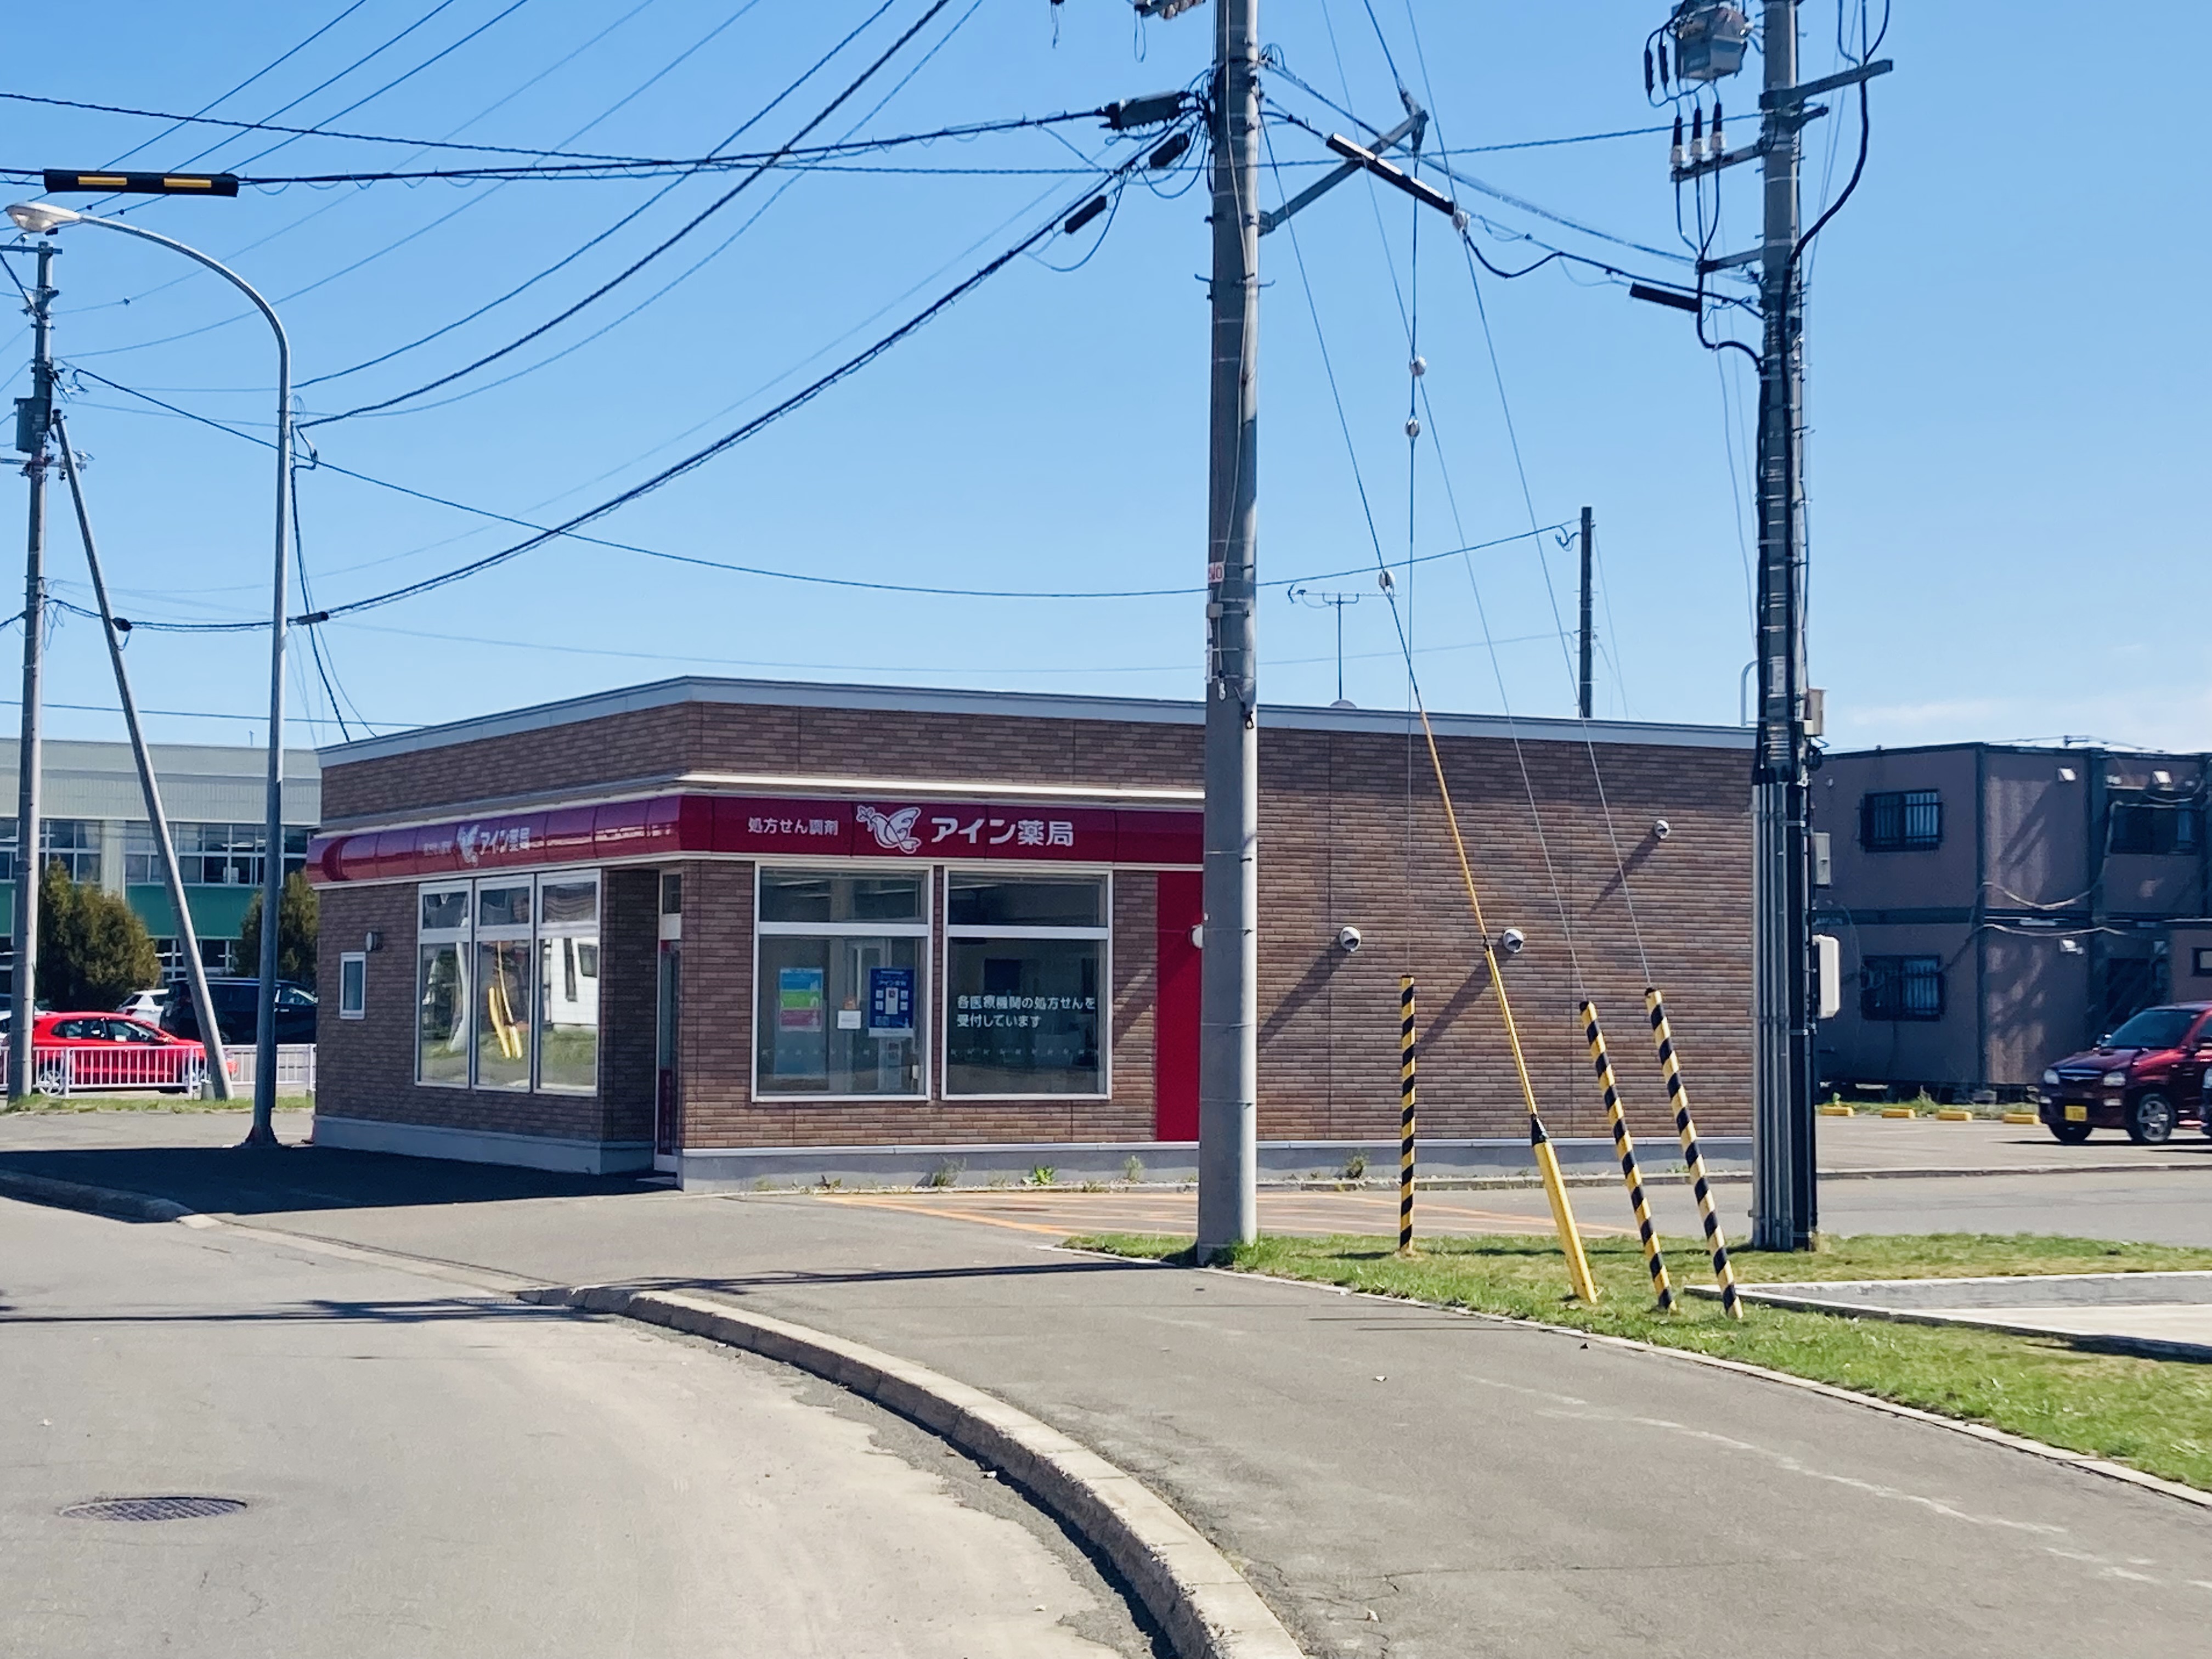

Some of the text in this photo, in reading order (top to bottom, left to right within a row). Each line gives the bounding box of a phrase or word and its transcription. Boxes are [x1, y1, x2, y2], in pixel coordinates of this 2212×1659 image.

[931, 816, 1074, 847] アイン薬局
[957, 1013, 1041, 1028] 受付しています
